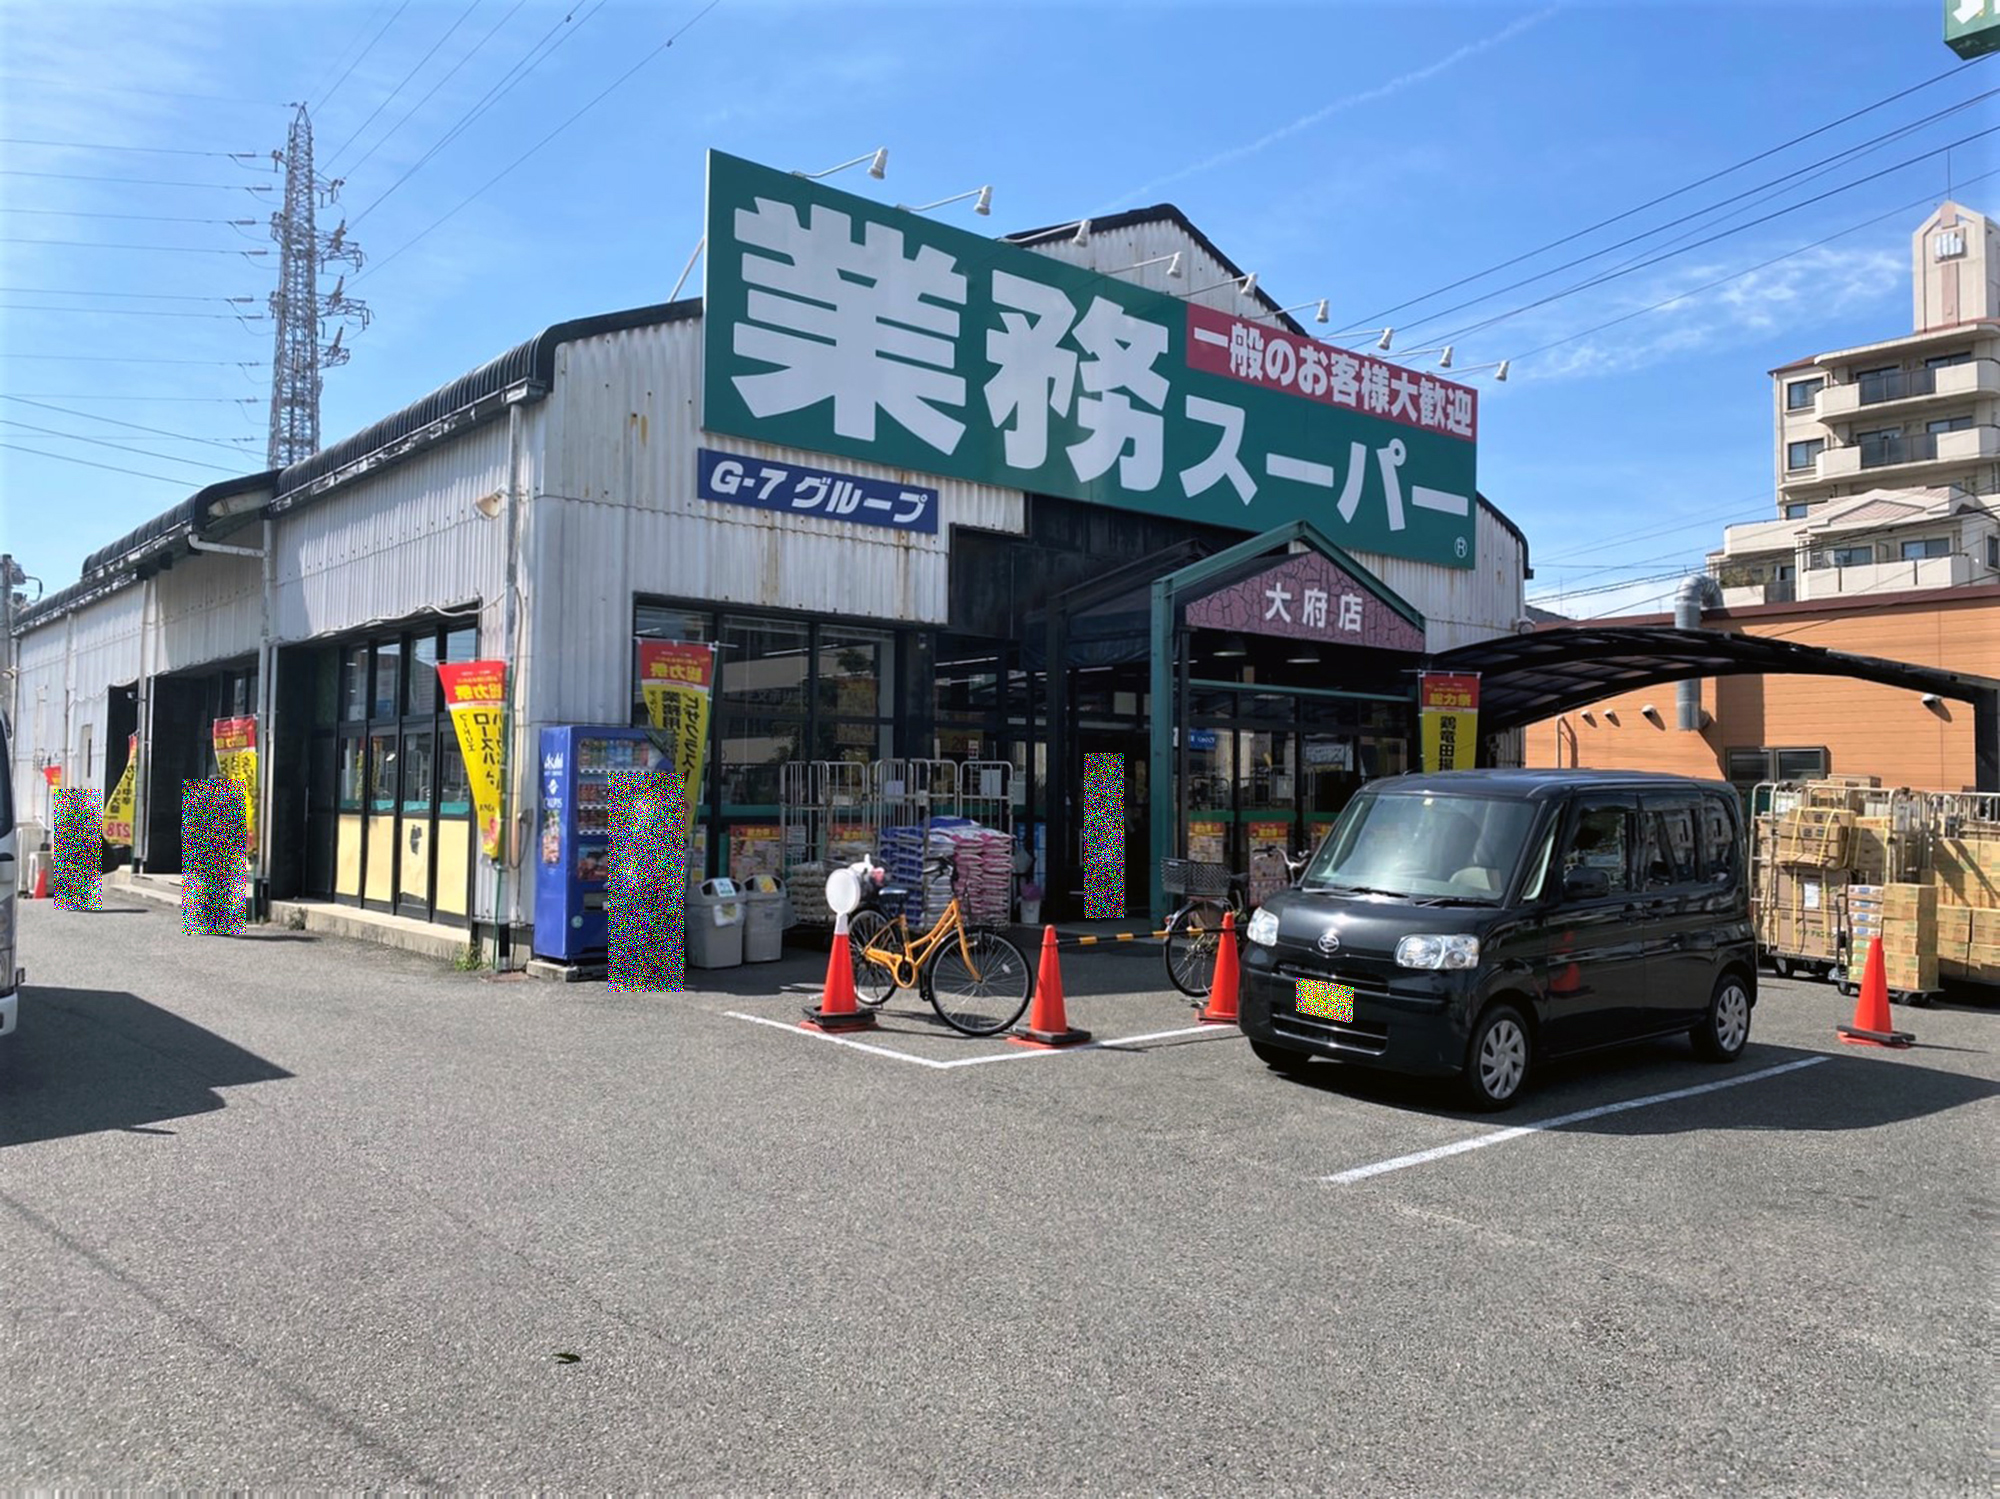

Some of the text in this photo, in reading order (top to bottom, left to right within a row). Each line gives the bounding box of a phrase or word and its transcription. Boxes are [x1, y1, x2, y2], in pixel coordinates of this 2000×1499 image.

[731, 197, 1468, 532] 業務スーパー
[1194, 323, 1472, 437] 一般のお客様大歓迎
[710, 461, 928, 523] G-7 グループ
[1264, 582, 1364, 632] 大府店
